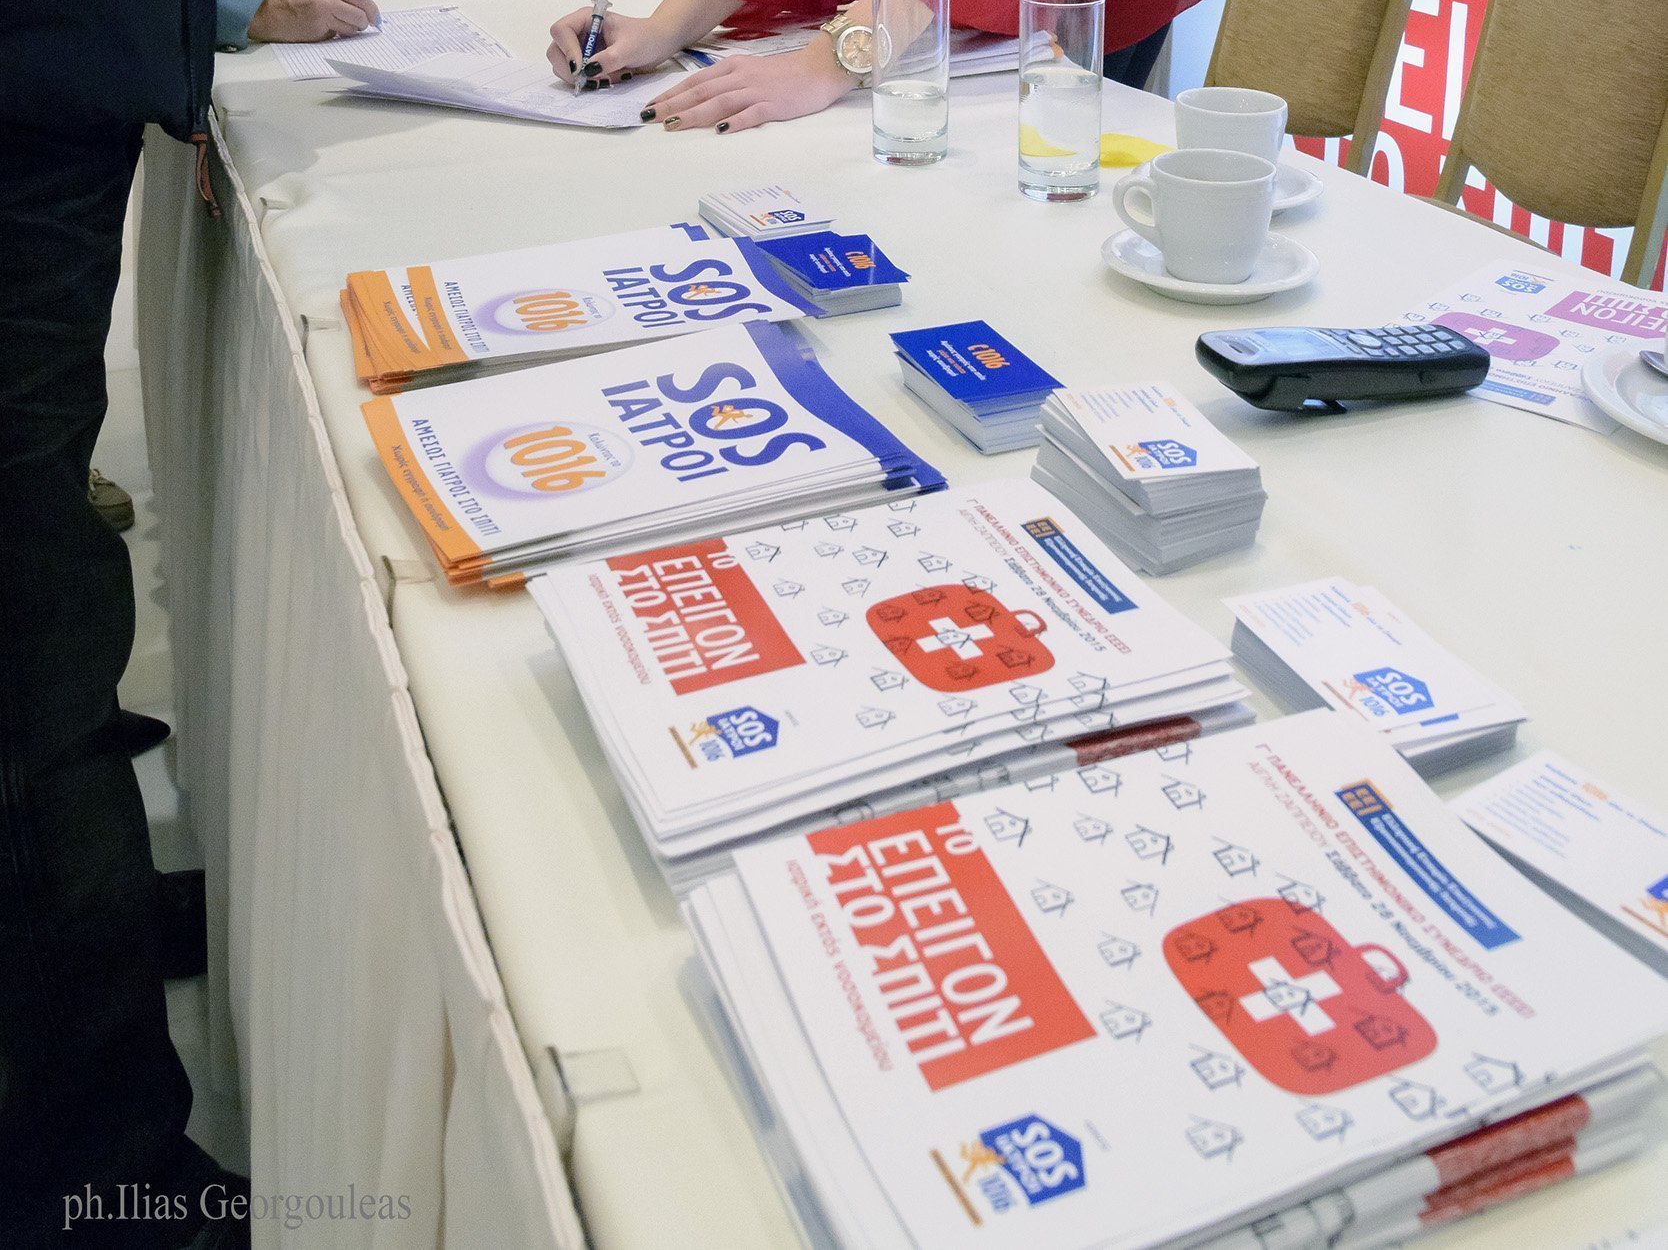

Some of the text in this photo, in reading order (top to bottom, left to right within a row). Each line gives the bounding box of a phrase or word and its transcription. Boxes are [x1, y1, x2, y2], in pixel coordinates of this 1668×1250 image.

[512, 291, 588, 332] 1016
[602, 266, 687, 329] ΙΑΤΡΟΙ
[649, 259, 773, 321] SOS
[601, 379, 730, 483] ΙΑΤΡΟΙ
[656, 361, 827, 467] SOS
[412, 418, 447, 461] ΑΜΕΣΩΣ
[433, 461, 470, 499] ΓΙΑΤΡΟΣ
[458, 496, 484, 516] ΣΤΟ
[503, 425, 607, 492] 1016
[1157, 442, 1192, 464] SOS
[612, 564, 708, 682] ΣΤΟ ΣΠΙΤΙ
[652, 554, 761, 671] ΕΠΕΙΓΟΝ
[1375, 671, 1428, 706] SOS
[730, 709, 772, 748] SOS
[814, 844, 968, 1066] ΣΤΟ ΣΠΙΤΙ
[867, 829, 1036, 1046] ΕΠΕΙΓΟΝ
[1010, 1121, 1079, 1188] SOS
